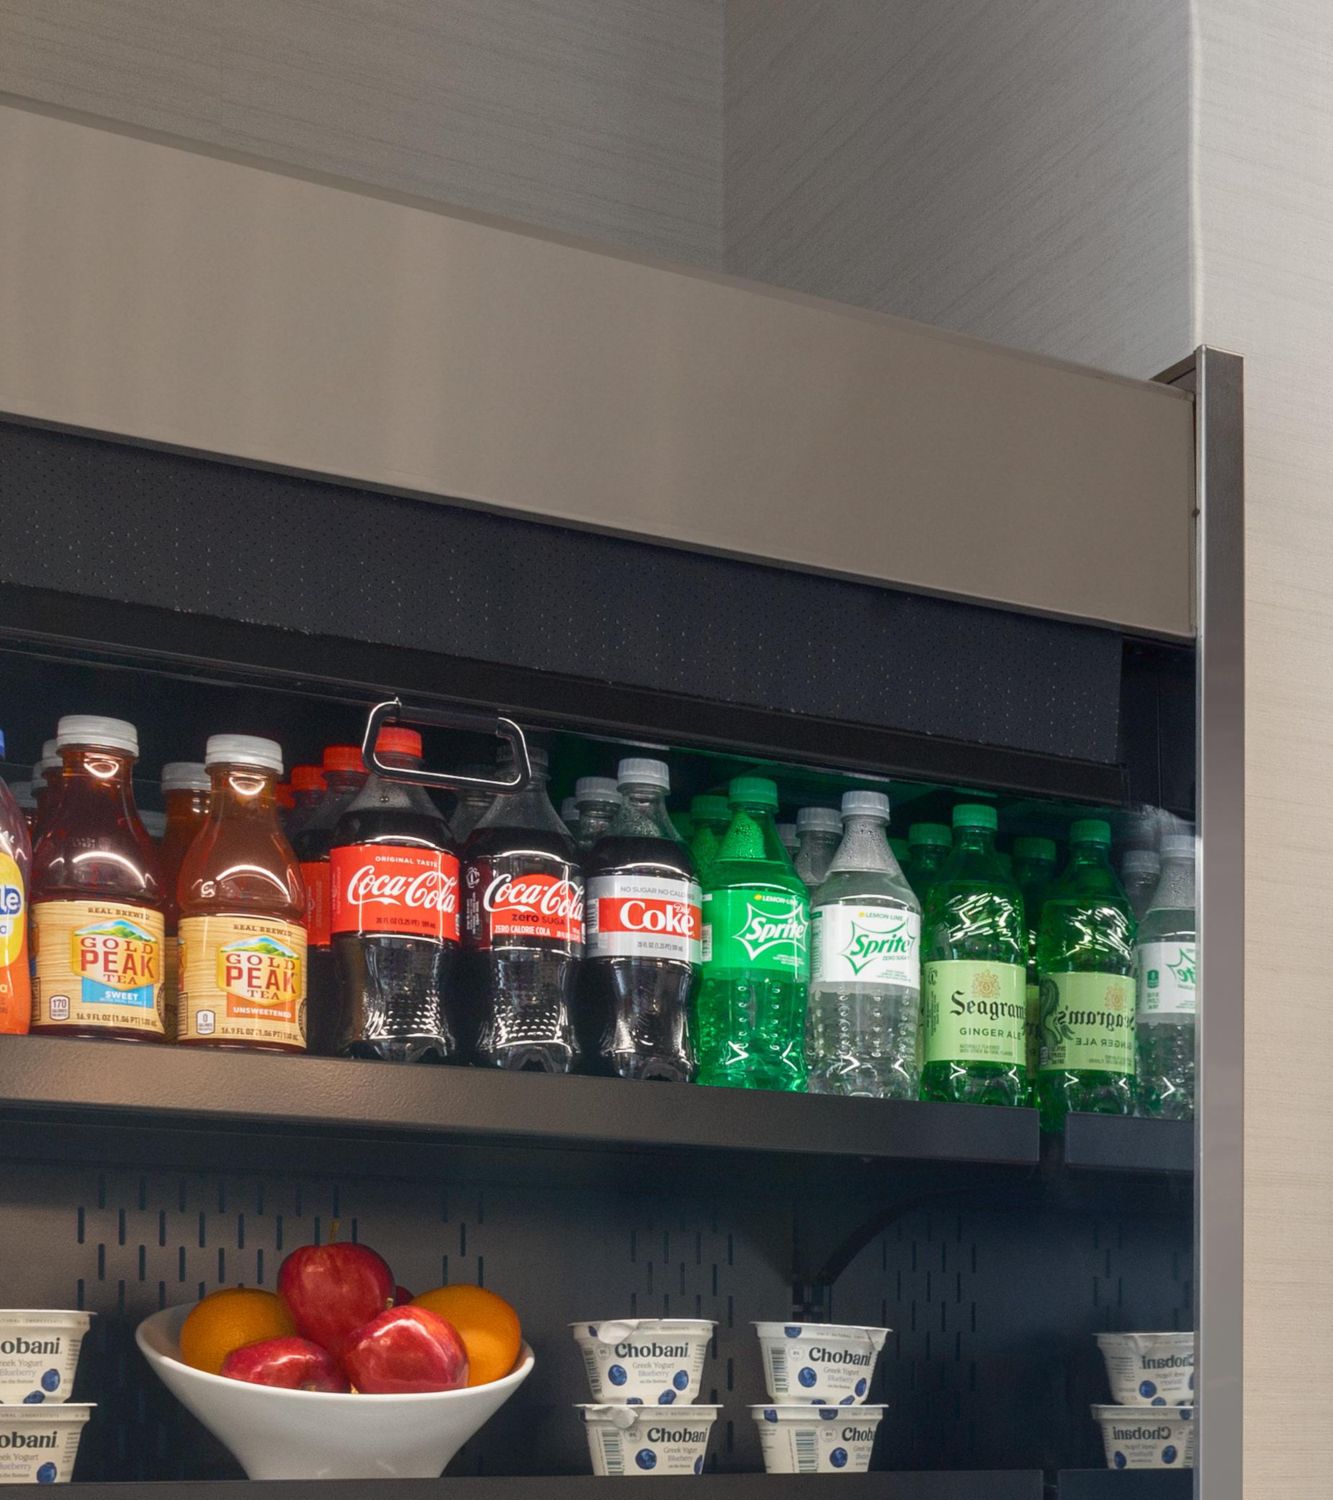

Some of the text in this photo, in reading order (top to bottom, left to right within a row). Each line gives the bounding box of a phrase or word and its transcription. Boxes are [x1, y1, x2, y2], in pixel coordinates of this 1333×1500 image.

[375, 856, 414, 865] ORIGINAL
[347, 865, 457, 913] Coca-Cola
[483, 874, 585, 921] Coca-Cola
[511, 912, 539, 923] zero
[620, 901, 694, 936] Coke
[746, 918, 804, 944] Sprite
[80, 936, 154, 955] GOLD
[851, 934, 911, 958] Sprite
[81, 950, 154, 979] PEAK
[226, 953, 296, 970] GOLD
[103, 974, 137, 985] TEA
[225, 966, 296, 994] PEAK
[105, 990, 138, 1001] SWEET
[247, 989, 279, 1000] TEA
[960, 1027, 1003, 1038] GINGER
[615, 1343, 689, 1358] Chobani
[808, 1347, 872, 1366] Chobani
[647, 1427, 706, 1444] Chobani
